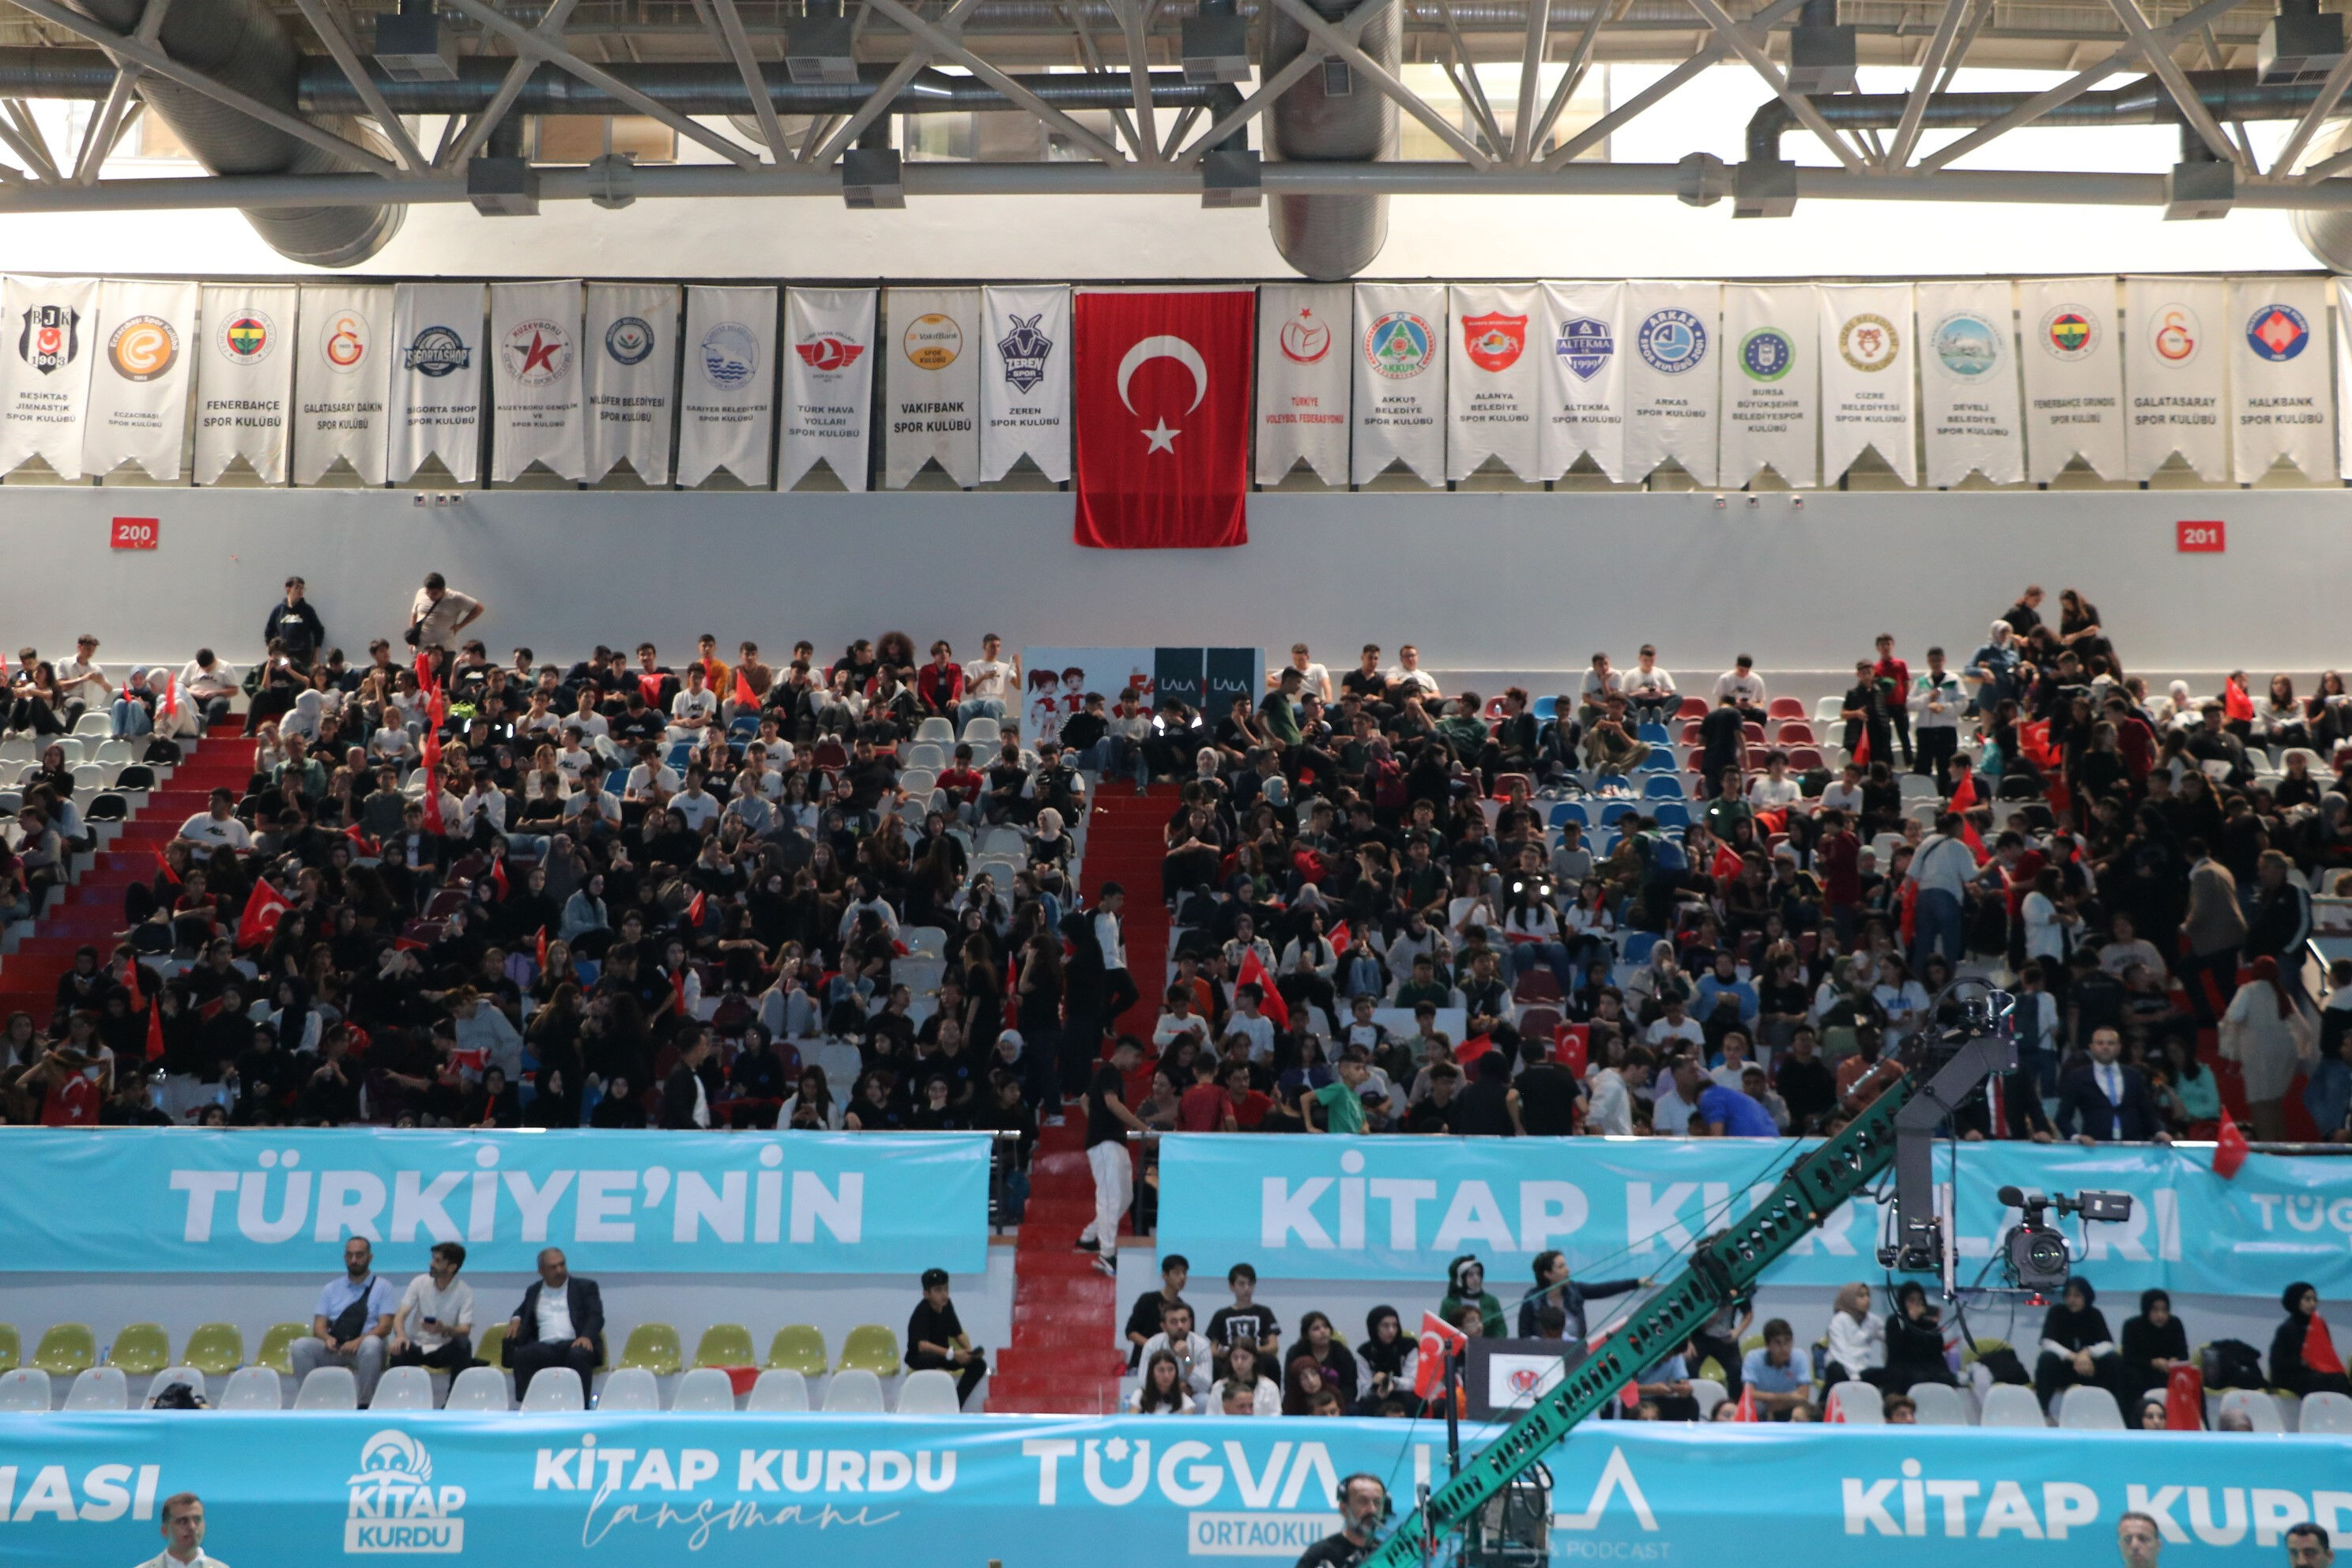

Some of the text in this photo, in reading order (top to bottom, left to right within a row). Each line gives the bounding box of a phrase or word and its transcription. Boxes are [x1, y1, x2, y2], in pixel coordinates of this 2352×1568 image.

[1649, 311, 1697, 327] ARKAS
[1560, 339, 1610, 349] ALTEKMA
[32, 356, 65, 367] 1903
[1005, 357, 1043, 371] ZEREN
[1572, 360, 1599, 370] 1999
[21, 392, 68, 401] BEŞİKTAŞ
[623, 397, 665, 407] BELEDİYESİ
[207, 401, 280, 411] FENERBAHÇE
[304, 401, 383, 413] GALATASARAY DAİKİN
[902, 402, 964, 413] VAKIFBANK
[1737, 400, 1799, 409] BÜYÜKŞEHİR
[2135, 398, 2216, 407] GALATASARAY
[2248, 398, 2313, 407] HALKBANK
[722, 404, 767, 413] BELEDİYESİ
[797, 405, 824, 413] TÜRK
[1666, 409, 1706, 418] KULÜBÜ
[36, 413, 76, 423] KULÜBÜ
[601, 411, 651, 422] SPOR KULÜBÜ
[1267, 414, 1297, 424] VOLEYBOL
[1732, 411, 1804, 420] BELEDİYESPOR
[1947, 415, 1996, 424] BELEDİYE
[2051, 415, 2069, 424] SPOR
[2135, 414, 2216, 425] SPOR KULÜBÜ
[2241, 413, 2323, 424] SPOR KULÜBÜ
[204, 416, 281, 427] SPOR KULÜBÜ
[318, 419, 368, 430] SPOR KULÜBÜ
[895, 418, 971, 433] SPOR KULÜBÜ
[819, 428, 859, 437] KULÜBÜ
[1748, 424, 1787, 432] KULÜBÜ
[1967, 427, 2008, 436] KULÜBÜ
[119, 525, 151, 540] 200
[2184, 529, 2217, 544] 201
[1162, 678, 1196, 692] LALA
[1214, 677, 1247, 692] LALA
[170, 1144, 864, 1244] TÜRKİYE’NİN
[1261, 1148, 1589, 1253] KİTAP
[533, 1432, 957, 1492] KİTAP KURDU
[1022, 1435, 1340, 1509] TÜGVA
[0, 1464, 160, 1522] ASI
[1841, 1457, 2100, 1540] KİTAP
[357, 1526, 450, 1548] KURDU
[1566, 1542, 1670, 1560] PODCAST
